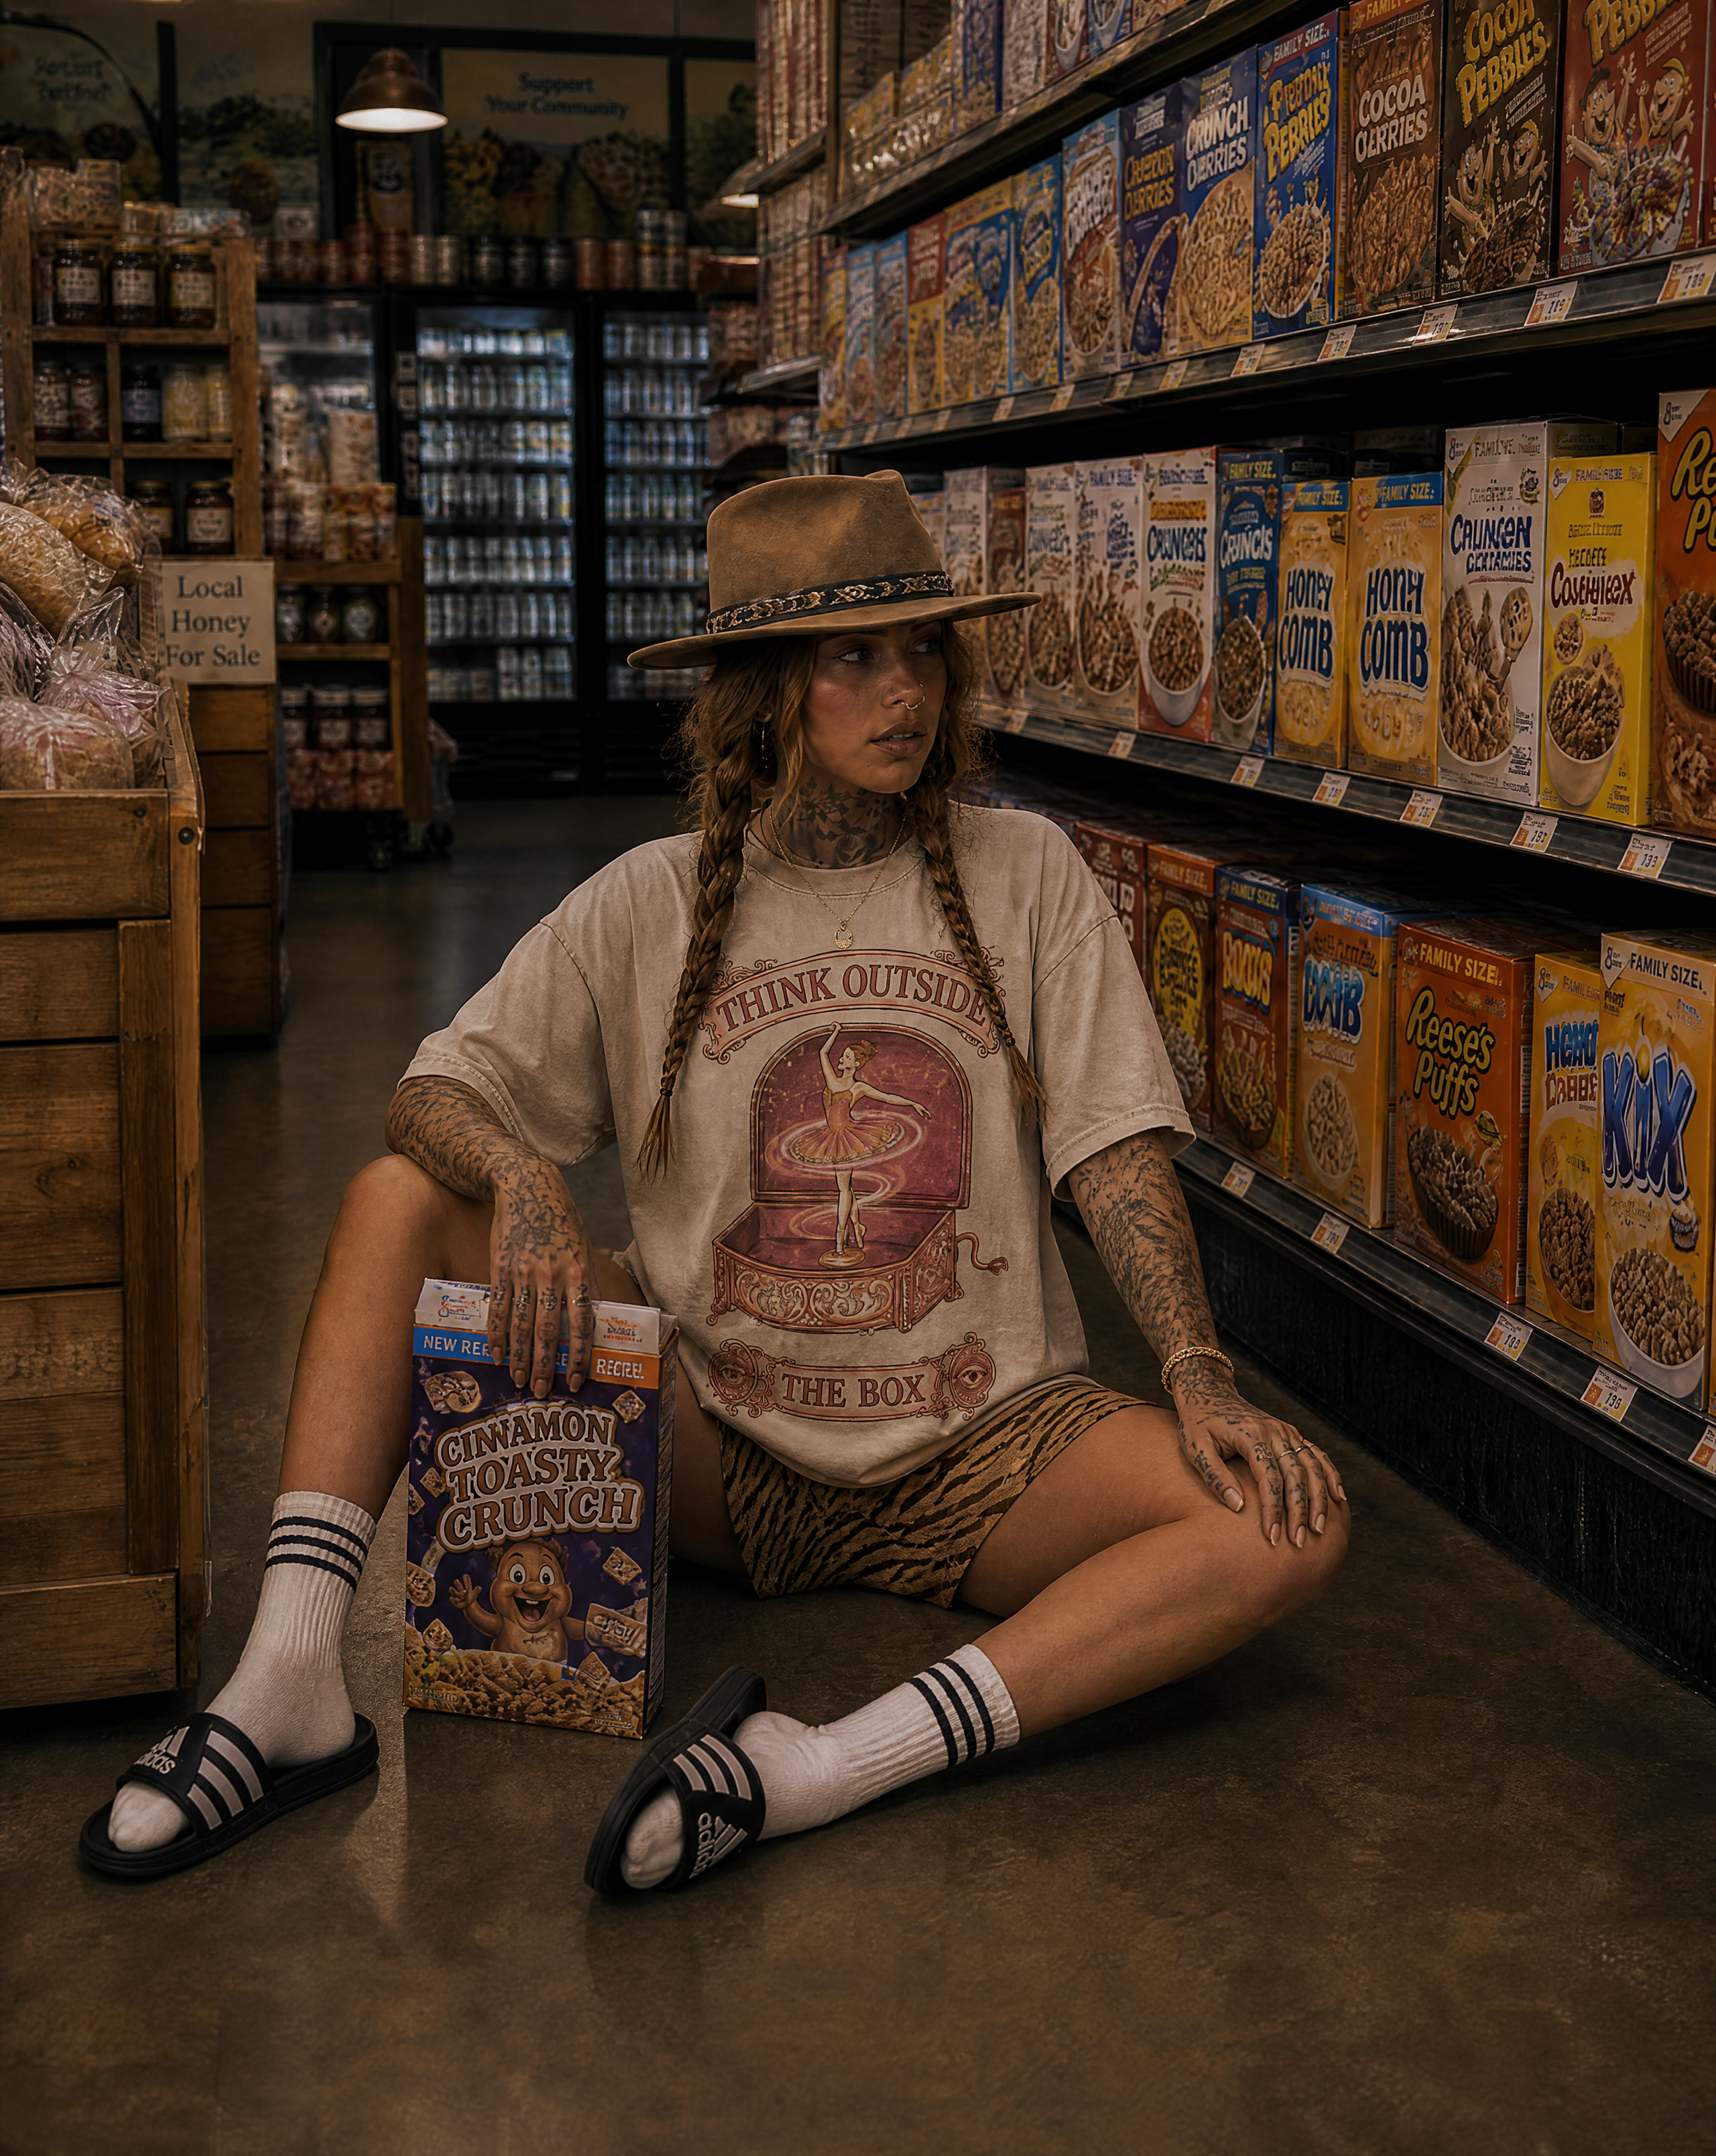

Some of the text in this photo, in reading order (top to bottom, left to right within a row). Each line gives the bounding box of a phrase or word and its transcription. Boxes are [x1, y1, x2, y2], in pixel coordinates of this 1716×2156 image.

[517, 71, 595, 94] Support
[485, 94, 629, 121] Your Community
[1359, 74, 1426, 127] COCOA
[177, 575, 243, 599] Local
[172, 609, 252, 639] Honey
[166, 642, 261, 667] For Sale
[1361, 619, 1428, 688] COMB
[1420, 943, 1463, 974] FAMILY
[1630, 953, 1669, 979] FAMILY
[716, 964, 986, 1032] THINK OUTSIDE
[1406, 988, 1494, 1071] Reese's
[1414, 1050, 1479, 1116] Puffs
[424, 1335, 457, 1353] NEW
[782, 1373, 926, 1408] THE BOX
[441, 1411, 613, 1468] CINNAMON
[449, 1447, 615, 1503] TOASTY
[444, 1487, 637, 1545] CRUNCH
